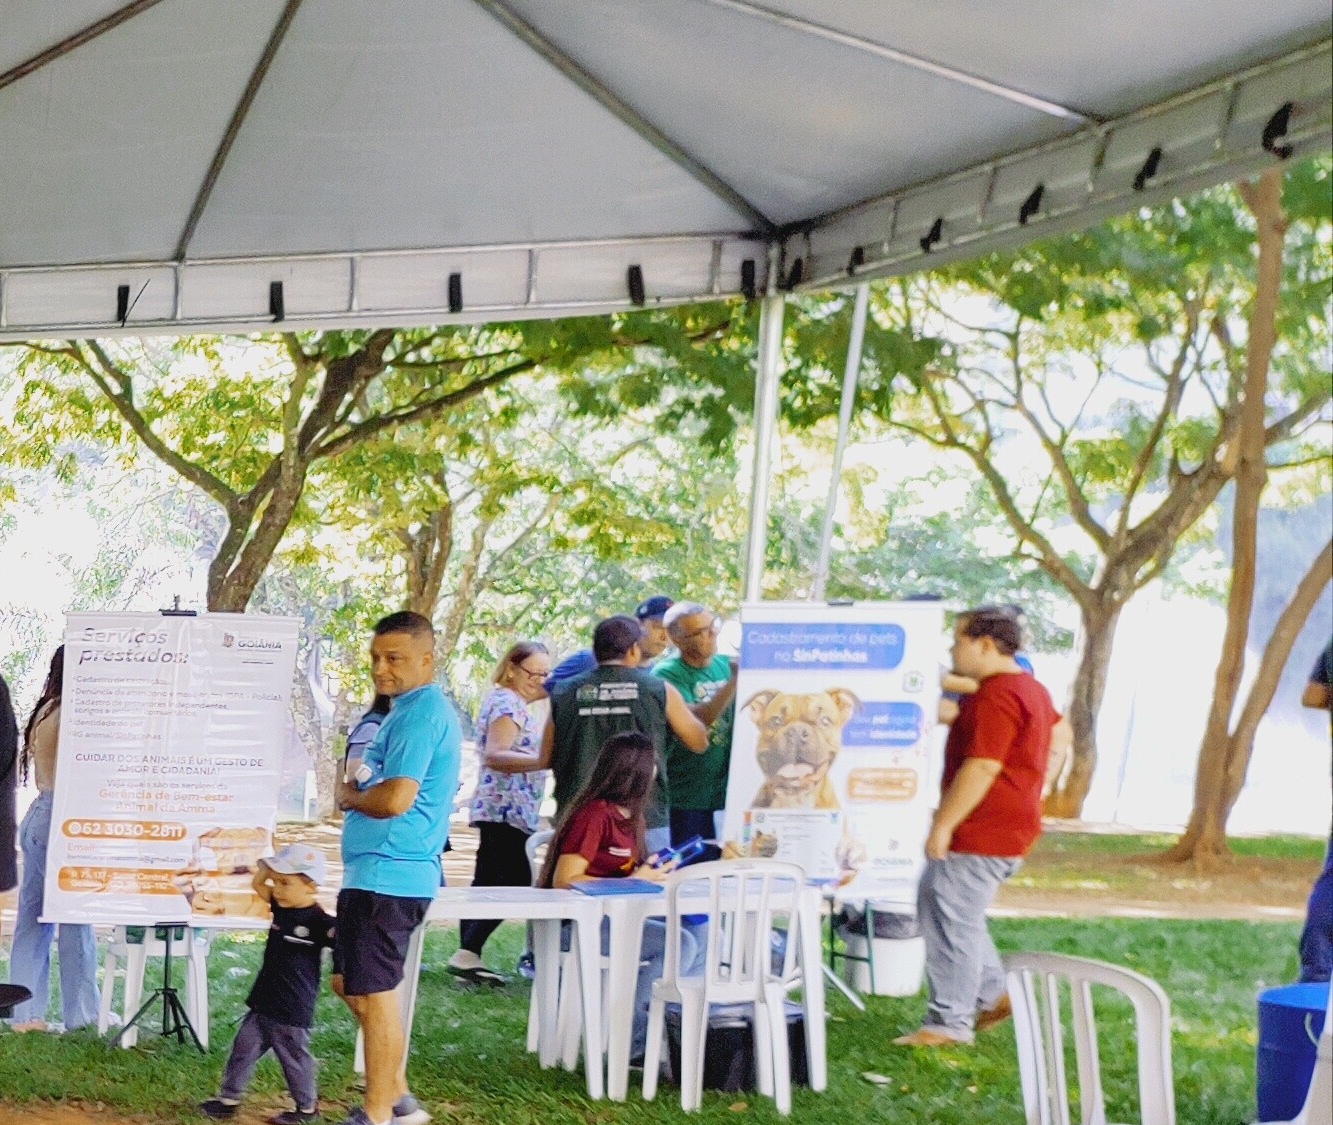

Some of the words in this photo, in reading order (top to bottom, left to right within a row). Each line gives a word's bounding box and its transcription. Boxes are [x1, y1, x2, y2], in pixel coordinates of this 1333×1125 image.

[82, 627, 167, 648] Serviços
[75, 753, 115, 762] CUIDAR
[142, 755, 186, 764] ANIMAIS
